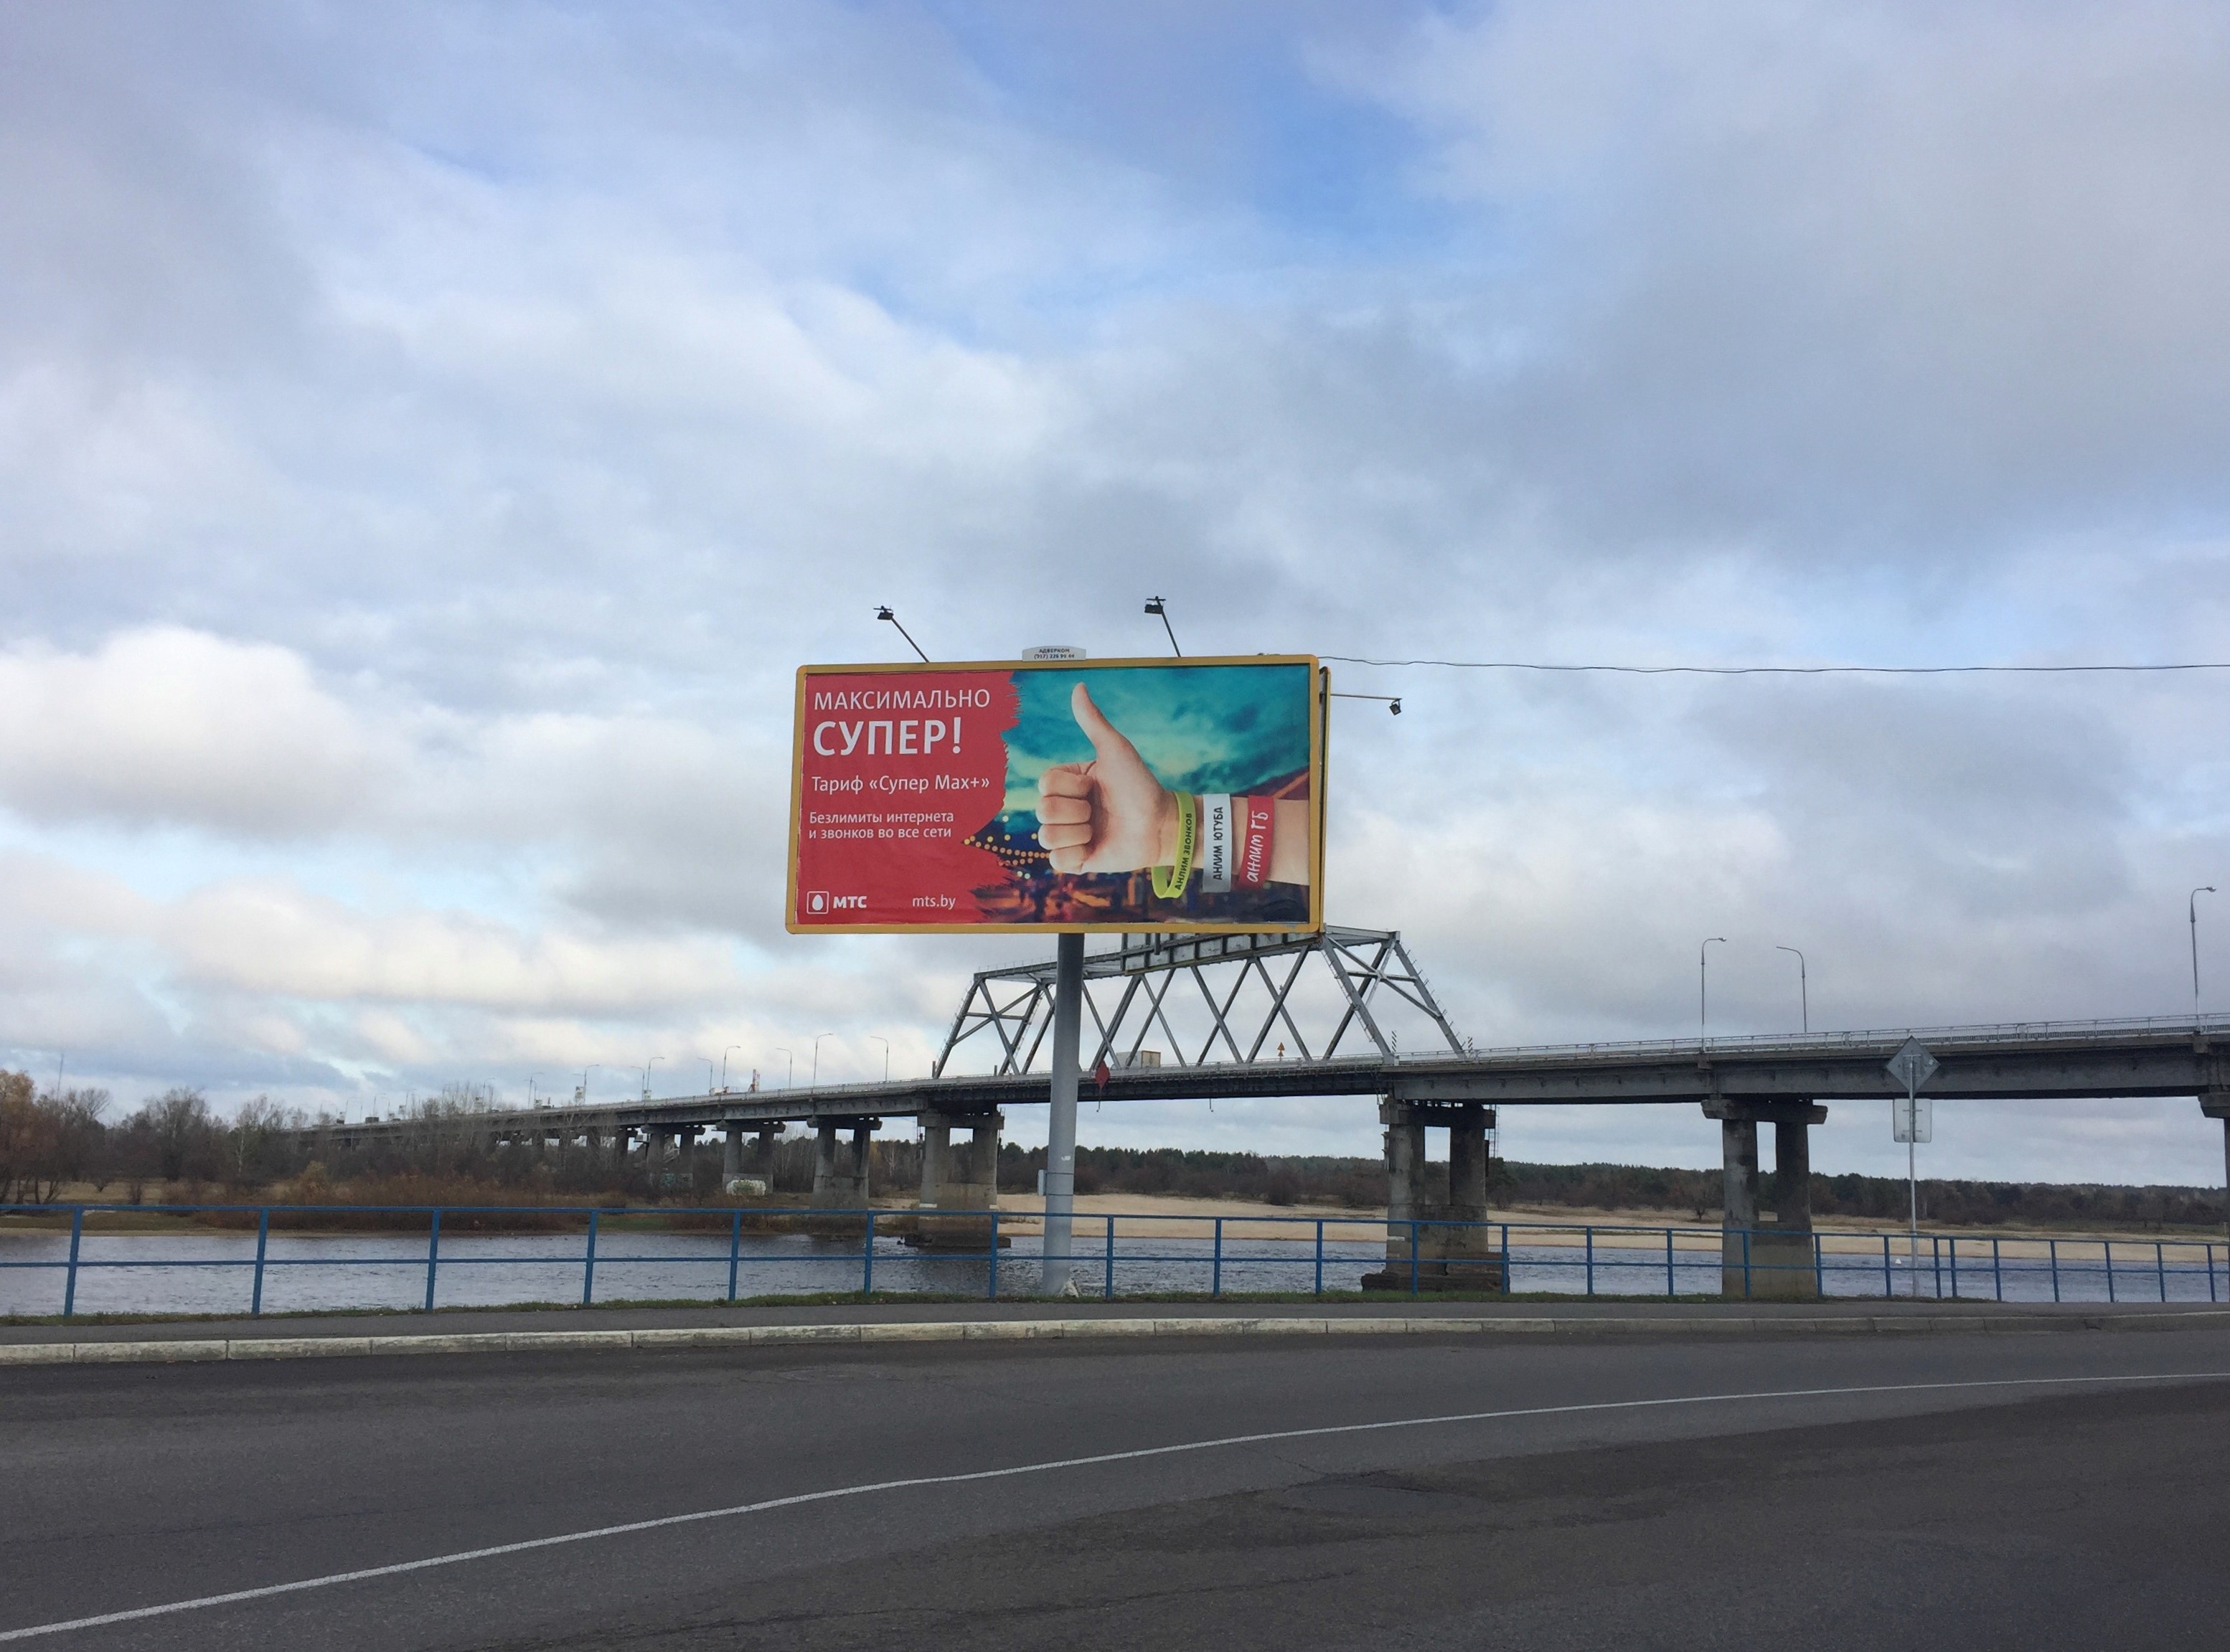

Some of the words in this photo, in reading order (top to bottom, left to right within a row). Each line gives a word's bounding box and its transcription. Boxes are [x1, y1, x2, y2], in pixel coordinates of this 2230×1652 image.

[814, 689, 990, 710] МАКСИМАЛЬНО
[813, 717, 961, 756] СУПЕР!
[811, 775, 863, 794] Тариф
[869, 775, 928, 794] «Супер
[809, 812, 882, 823] Безлимиты
[887, 812, 954, 823] интернета
[1214, 806, 1223, 841] ЮТУБА
[809, 830, 817, 839] и
[820, 829, 874, 839] звонков
[878, 829, 894, 838] во
[898, 829, 918, 838] все
[923, 828, 951, 837] сети
[1175, 858, 1189, 890] АНЛИМ
[1183, 813, 1192, 855] ЗВОНКОВ
[1247, 834, 1264, 882] анлим
[1213, 845, 1223, 880] АНЛИМ
[833, 895, 867, 909] МТС
[912, 895, 956, 910] mts.by
